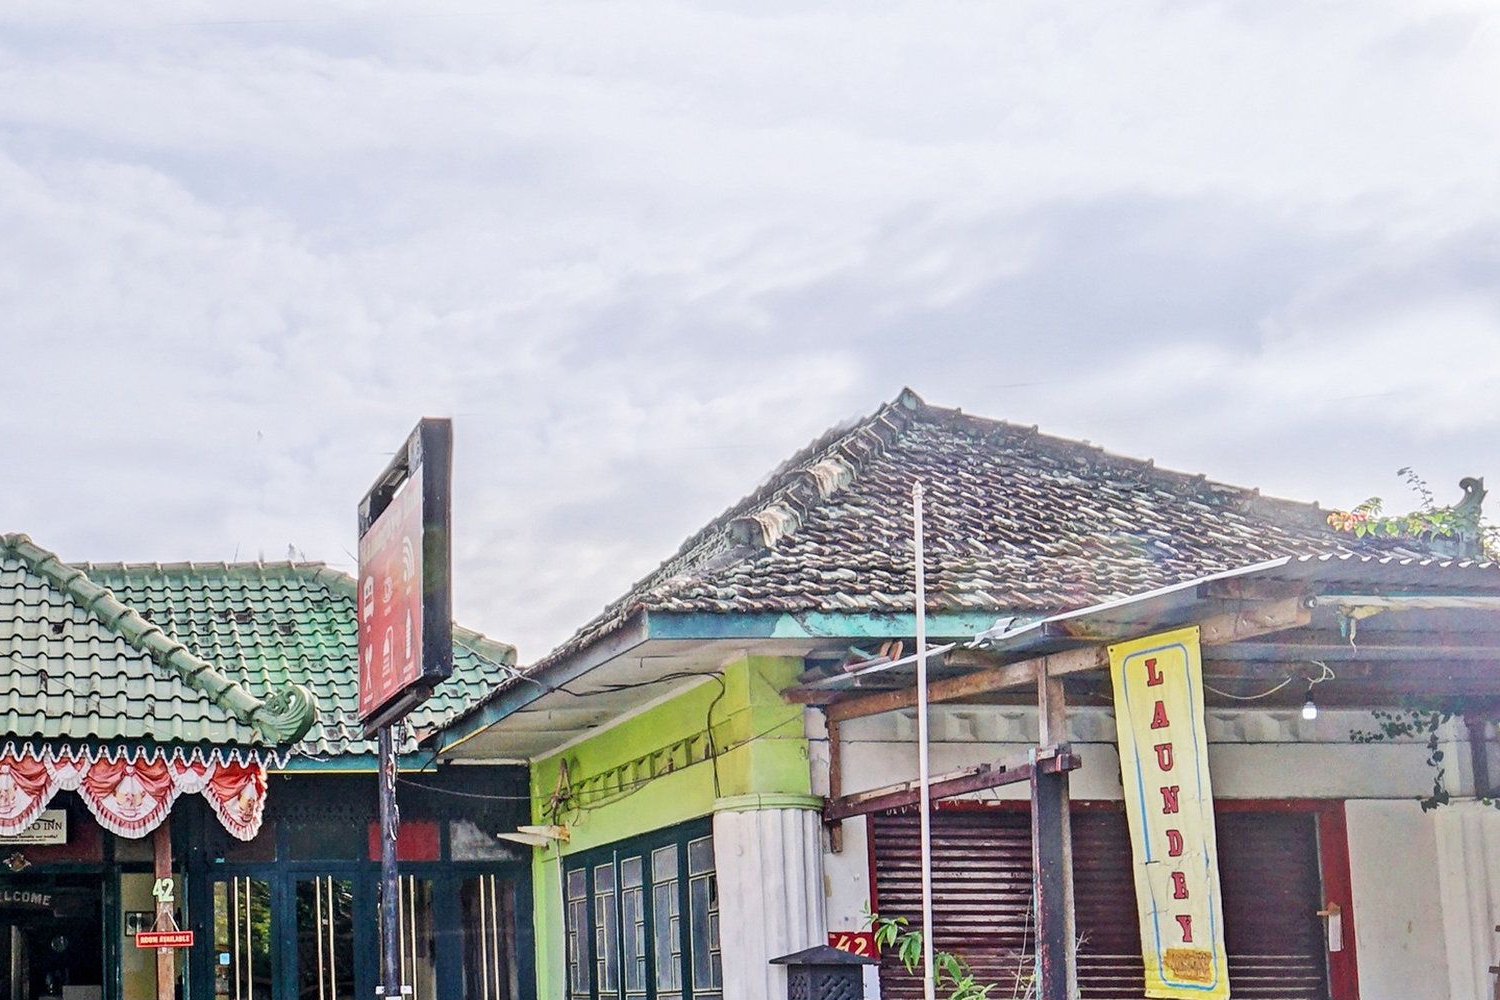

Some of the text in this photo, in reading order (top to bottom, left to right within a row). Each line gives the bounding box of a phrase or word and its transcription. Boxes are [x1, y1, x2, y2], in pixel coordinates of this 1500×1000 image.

[1144, 657, 1193, 943] LAUNDRY
[44, 822, 62, 831] INN
[152, 878, 175, 902] 42
[160, 935, 190, 943] AVAILABLE
[835, 934, 870, 958] 42
